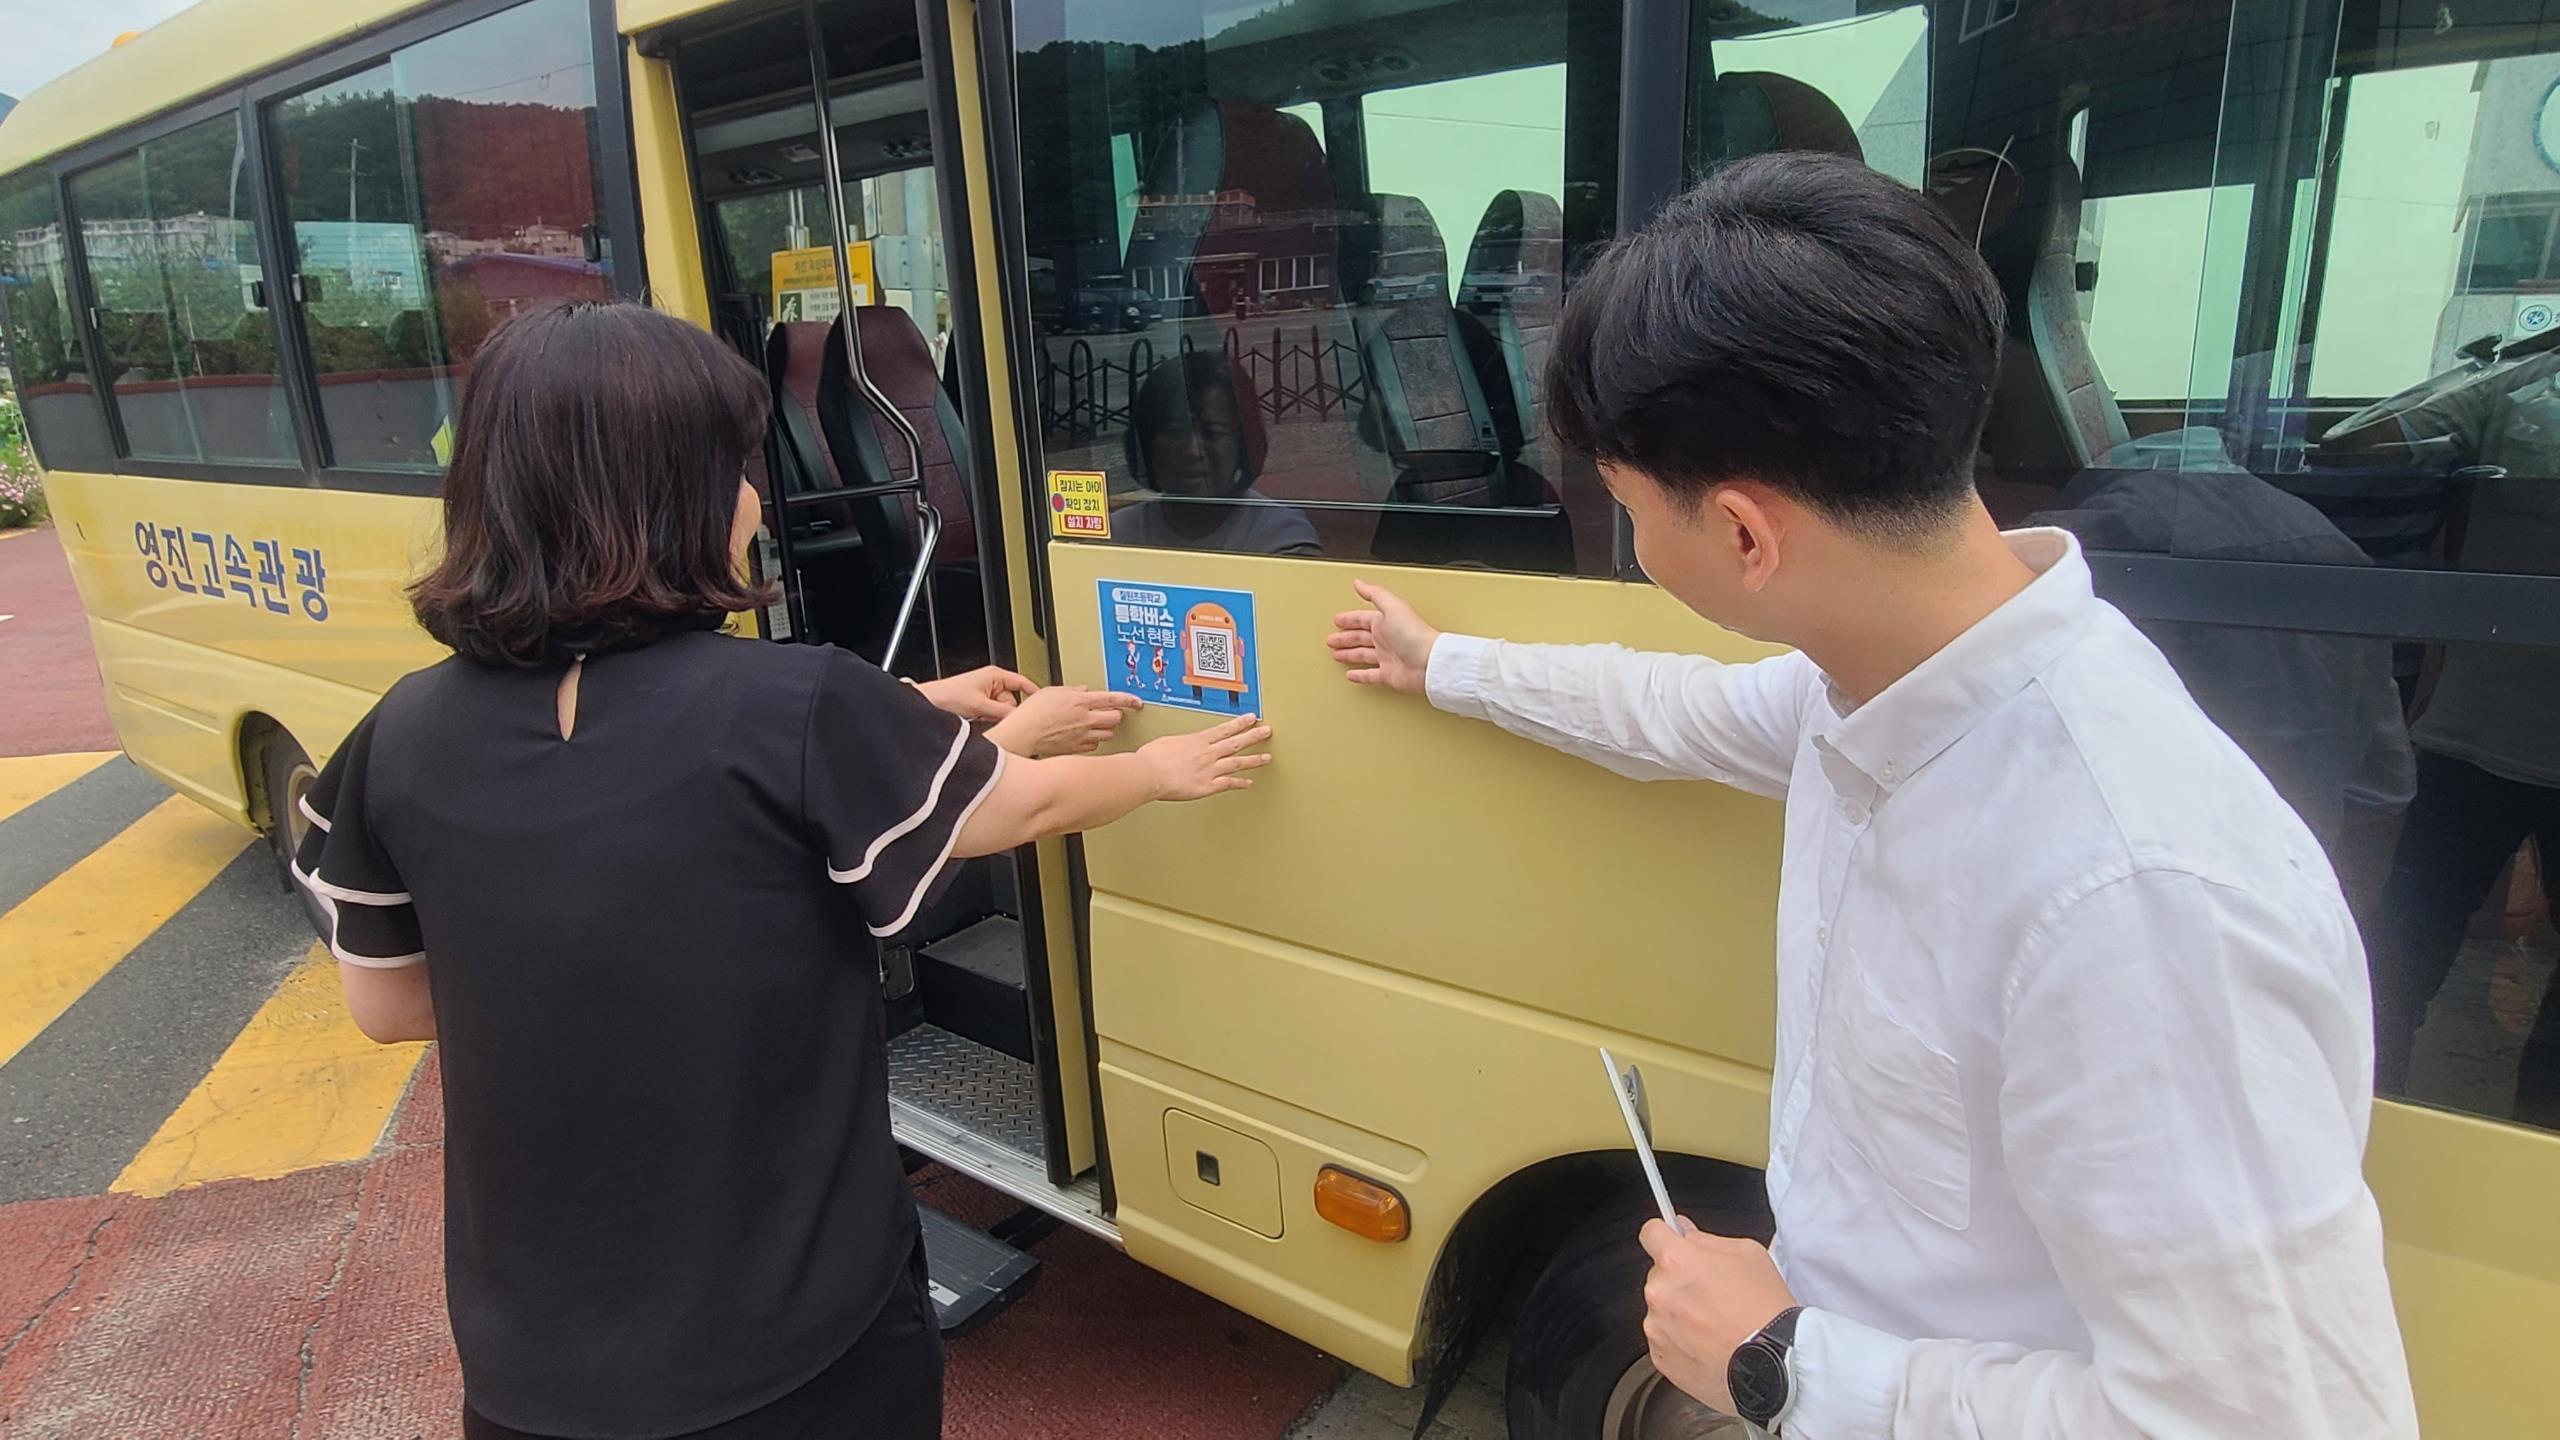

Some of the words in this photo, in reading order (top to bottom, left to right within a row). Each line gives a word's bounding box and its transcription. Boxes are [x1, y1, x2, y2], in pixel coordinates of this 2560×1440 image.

[1060, 480, 1083, 493] 잠자는
[1086, 481, 1102, 493] 아이
[1066, 498, 1081, 510] 확인
[1083, 499, 1100, 511] 장치
[1067, 515, 1084, 528] 설치
[1086, 517, 1102, 530] 차량
[135, 521, 329, 622] 영진고속관광
[1115, 603, 1174, 627] 통학버스
[1117, 624, 1146, 644] 노선
[1147, 627, 1177, 649] 현황
